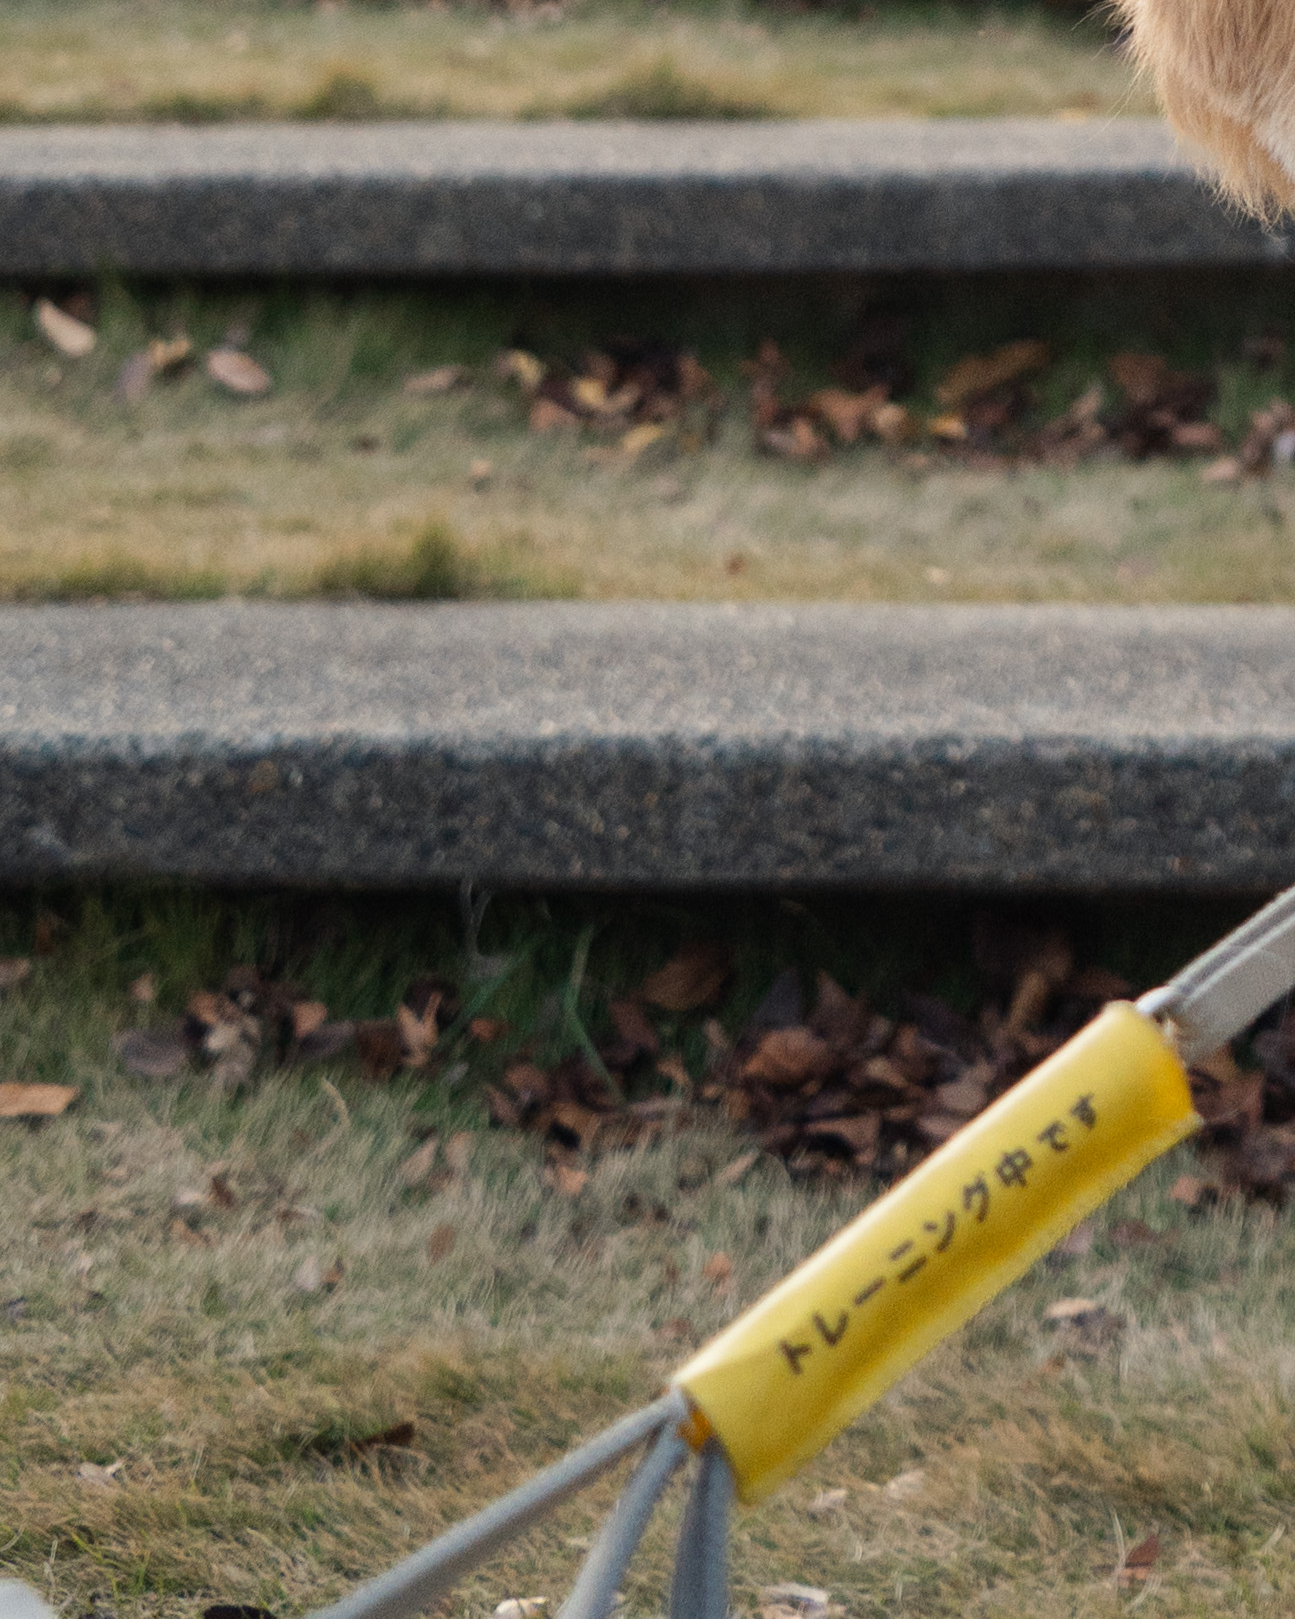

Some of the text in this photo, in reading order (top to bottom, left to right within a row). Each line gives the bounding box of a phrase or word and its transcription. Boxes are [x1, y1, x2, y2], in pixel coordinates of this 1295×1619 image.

[778, 1092, 1098, 1376] トレーニング中です
